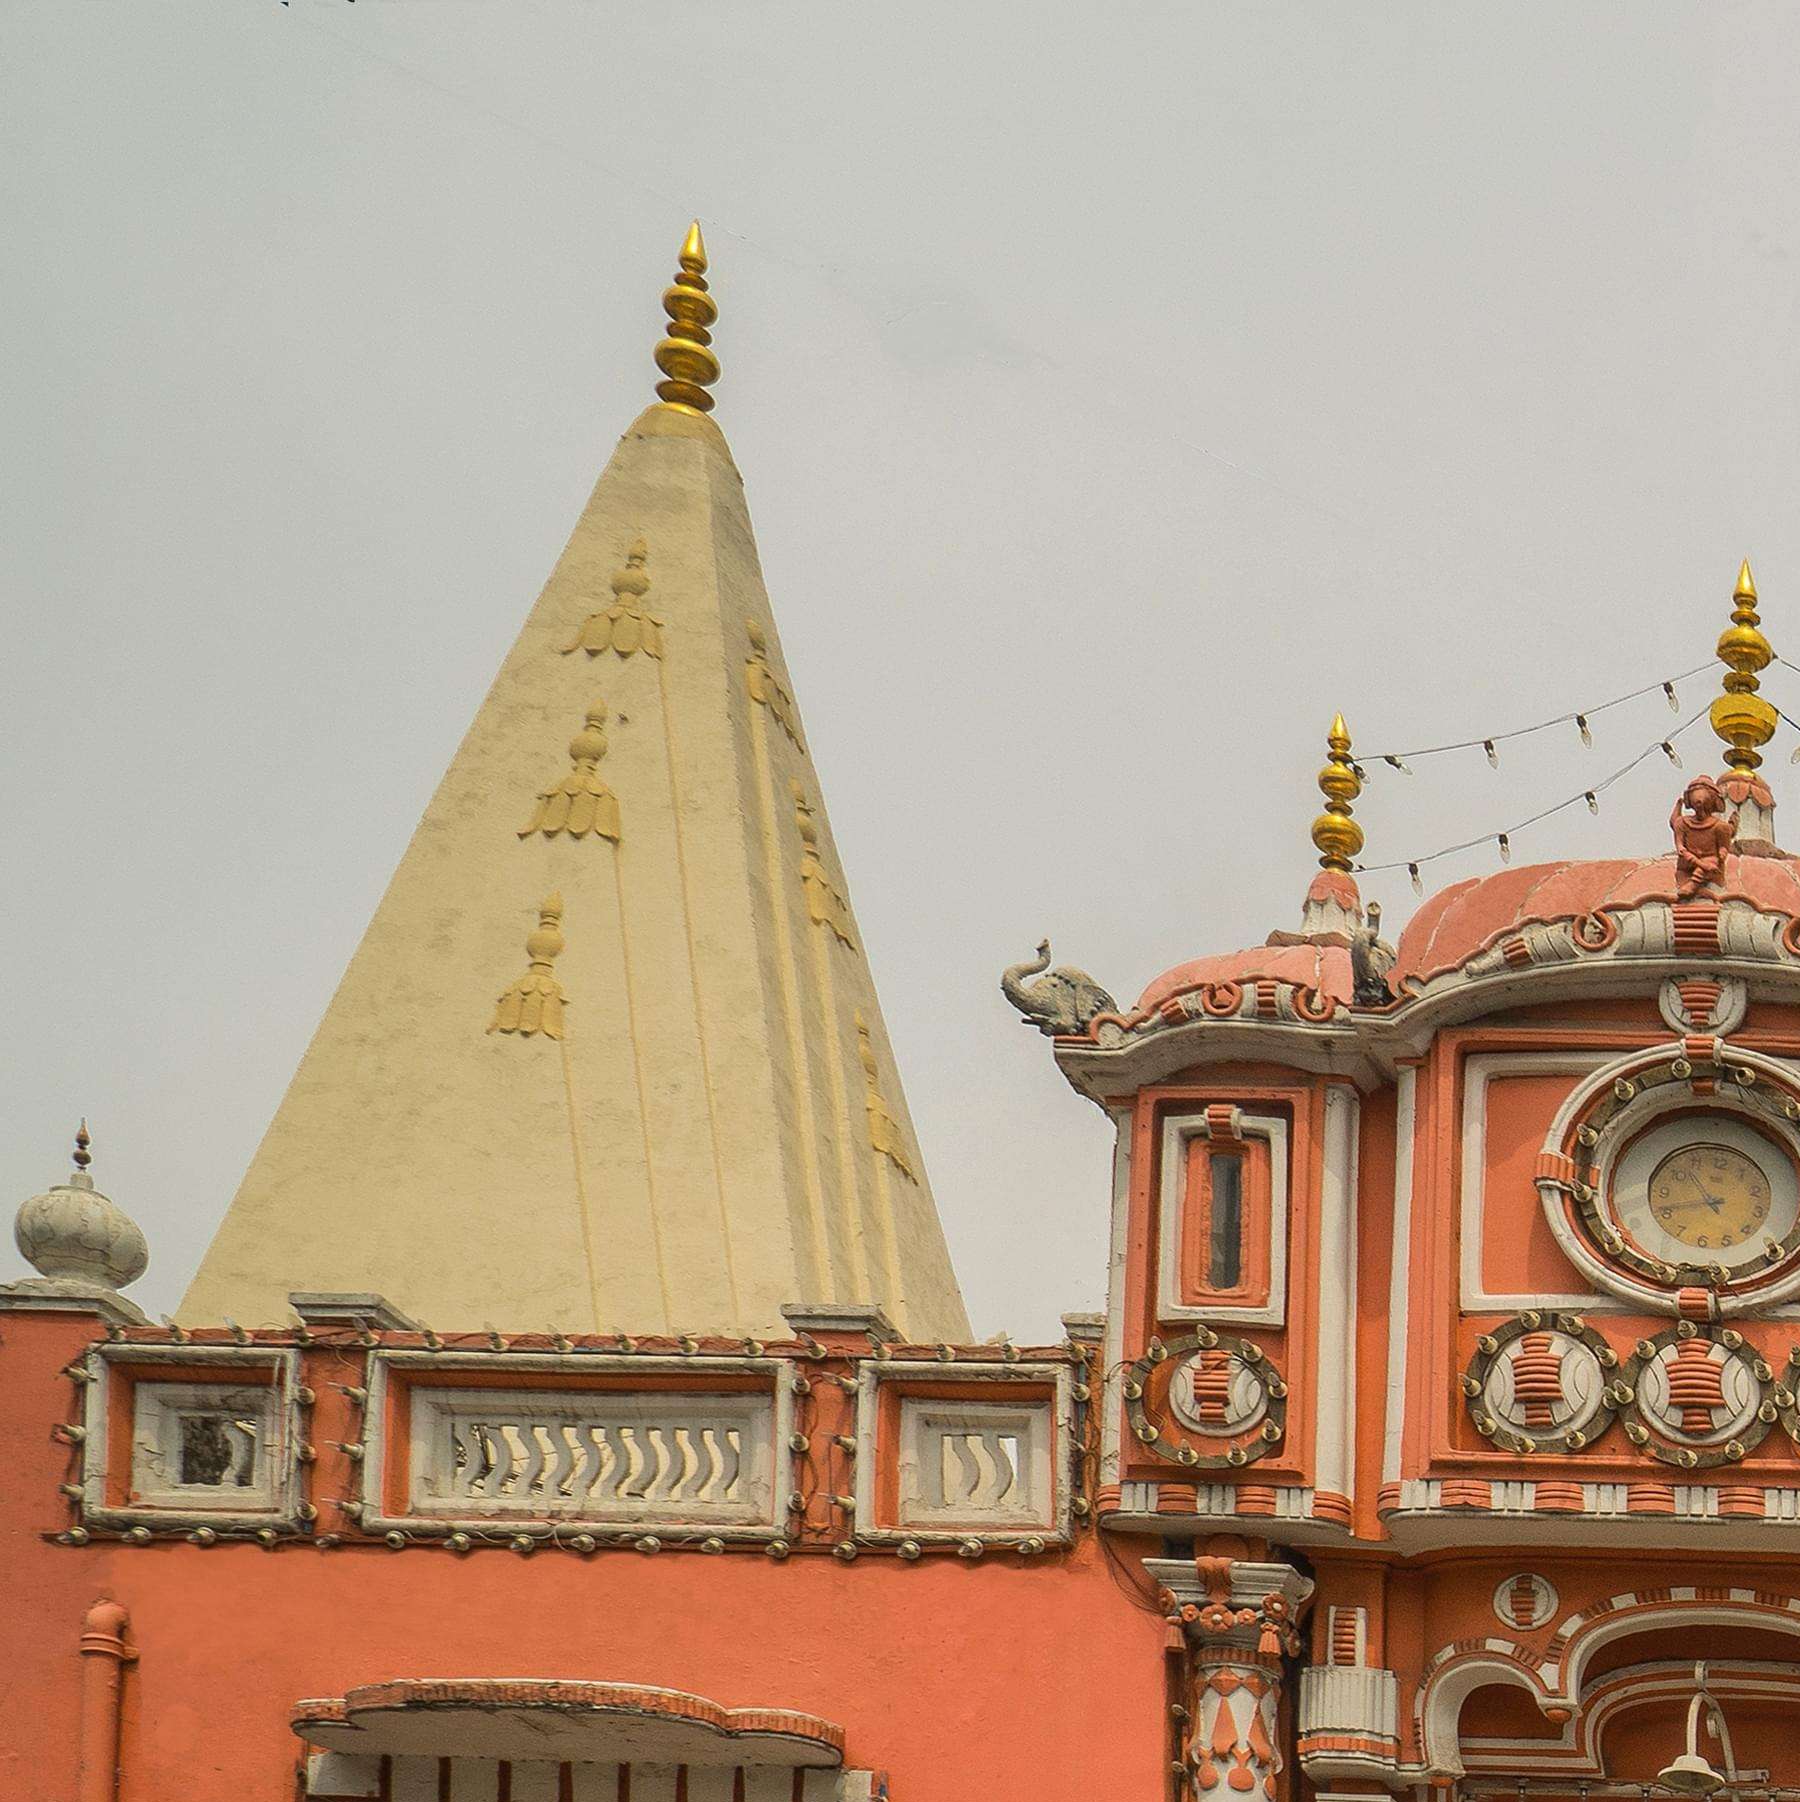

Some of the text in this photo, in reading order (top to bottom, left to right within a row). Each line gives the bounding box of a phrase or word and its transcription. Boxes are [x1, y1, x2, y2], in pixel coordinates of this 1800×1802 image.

[1714, 1158, 1728, 1170] 12
[1671, 1168, 1687, 1181] 10
[1659, 1187, 1670, 1199] 9
[1749, 1185, 1761, 1198] 2
[1753, 1205, 1764, 1219] 3
[1676, 1224, 1687, 1237] 7
[1697, 1235, 1709, 1248] 6
[1721, 1235, 1732, 1247] 5
